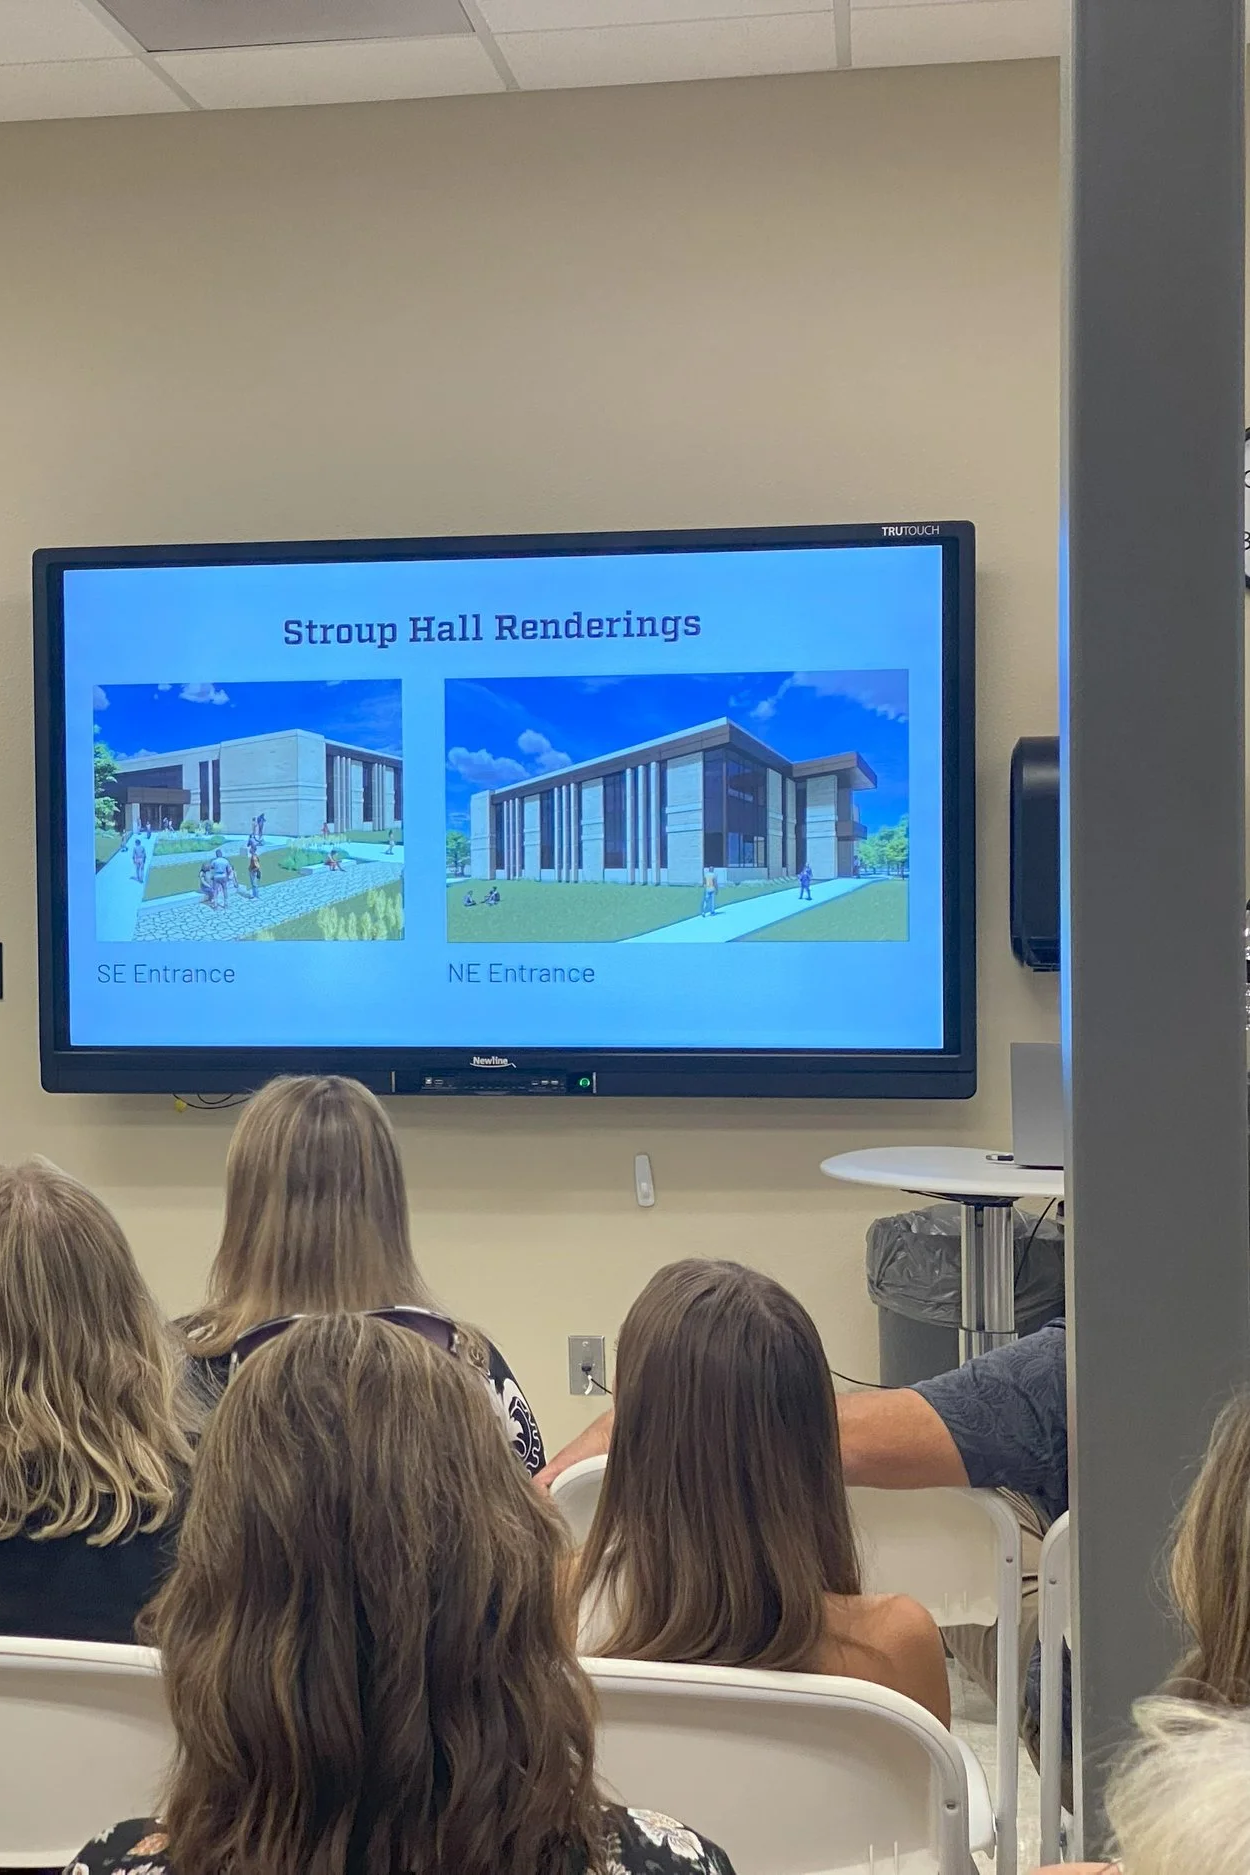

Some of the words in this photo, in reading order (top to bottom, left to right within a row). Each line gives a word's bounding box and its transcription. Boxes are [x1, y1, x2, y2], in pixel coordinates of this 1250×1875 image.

[881, 525, 940, 536] TRUTOUCH
[283, 617, 398, 649] Stroup
[408, 613, 484, 643] Hall
[494, 609, 702, 643] Renderings
[97, 963, 127, 984] SE
[134, 963, 236, 984] Entrance
[448, 963, 481, 983] NE
[489, 963, 596, 983] Entrance
[472, 1055, 508, 1065] Newline
